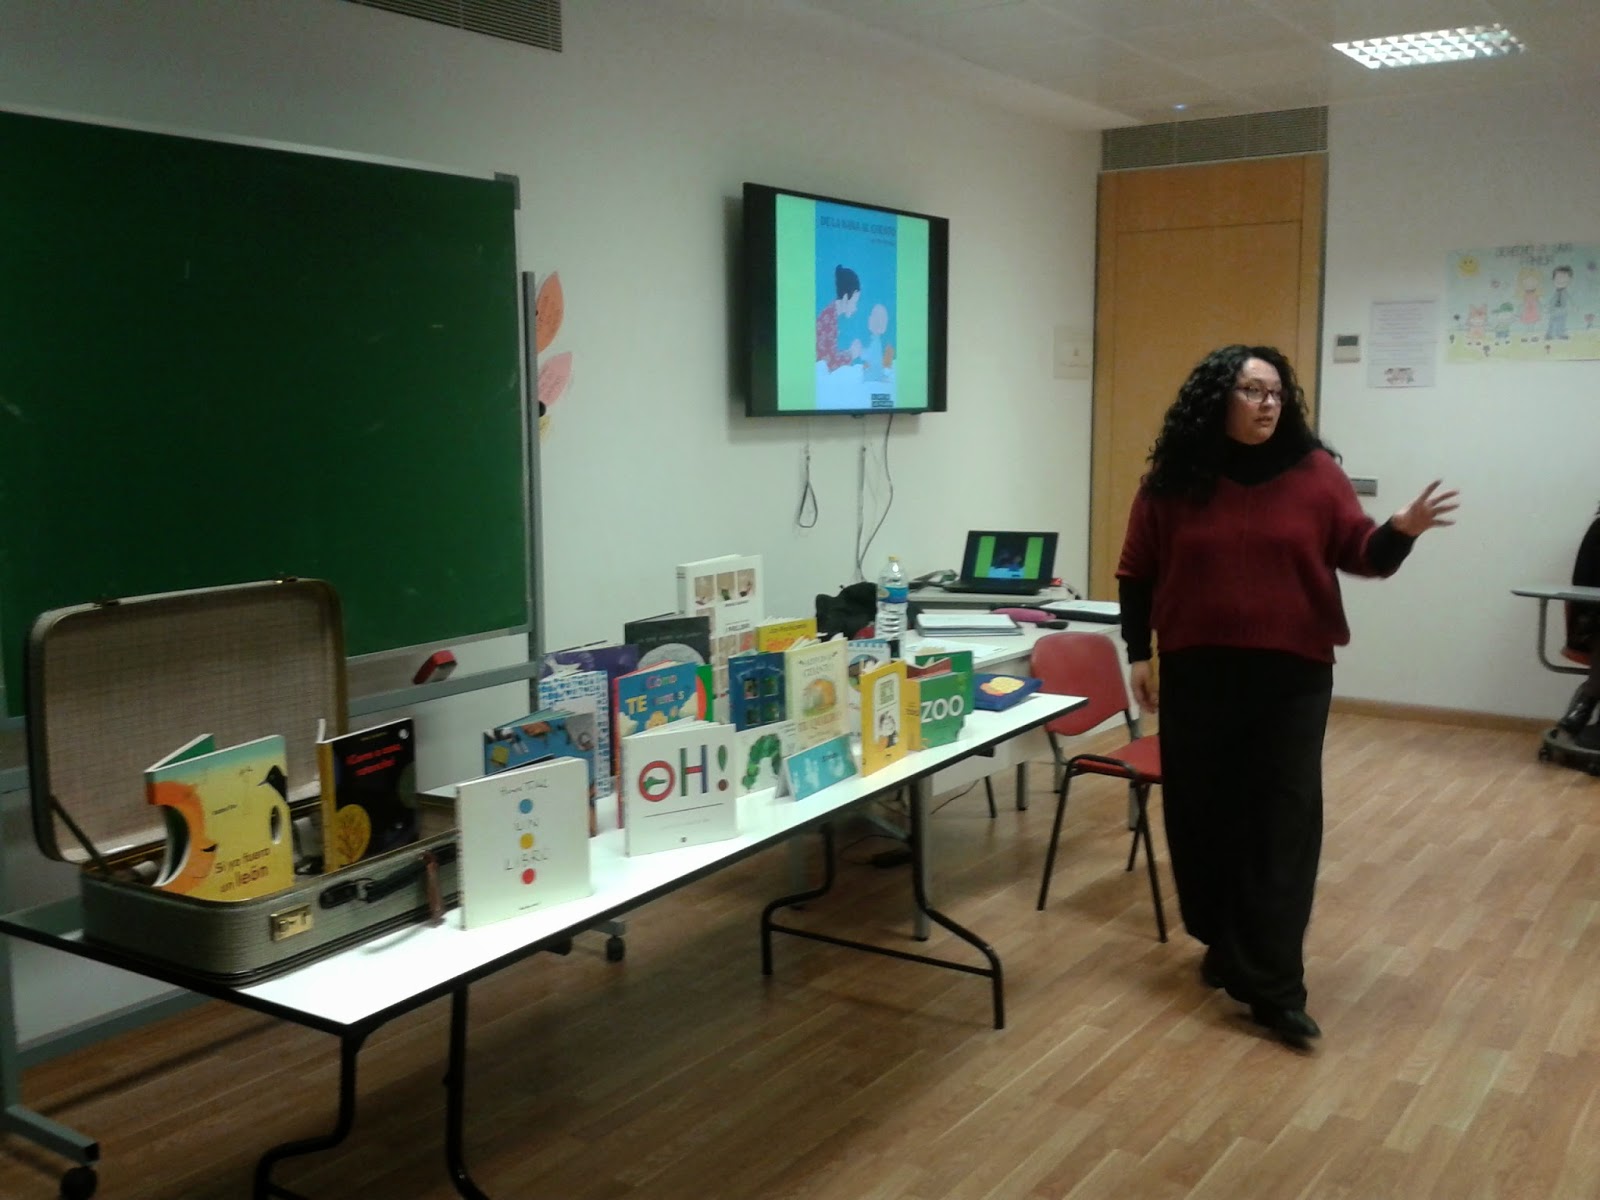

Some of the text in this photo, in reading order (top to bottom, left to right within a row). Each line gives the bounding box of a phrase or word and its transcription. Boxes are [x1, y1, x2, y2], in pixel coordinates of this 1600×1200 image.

[625, 694, 648, 715] TE
[920, 695, 965, 724] ZOO
[638, 744, 729, 803] OH!
[235, 865, 269, 887] león
